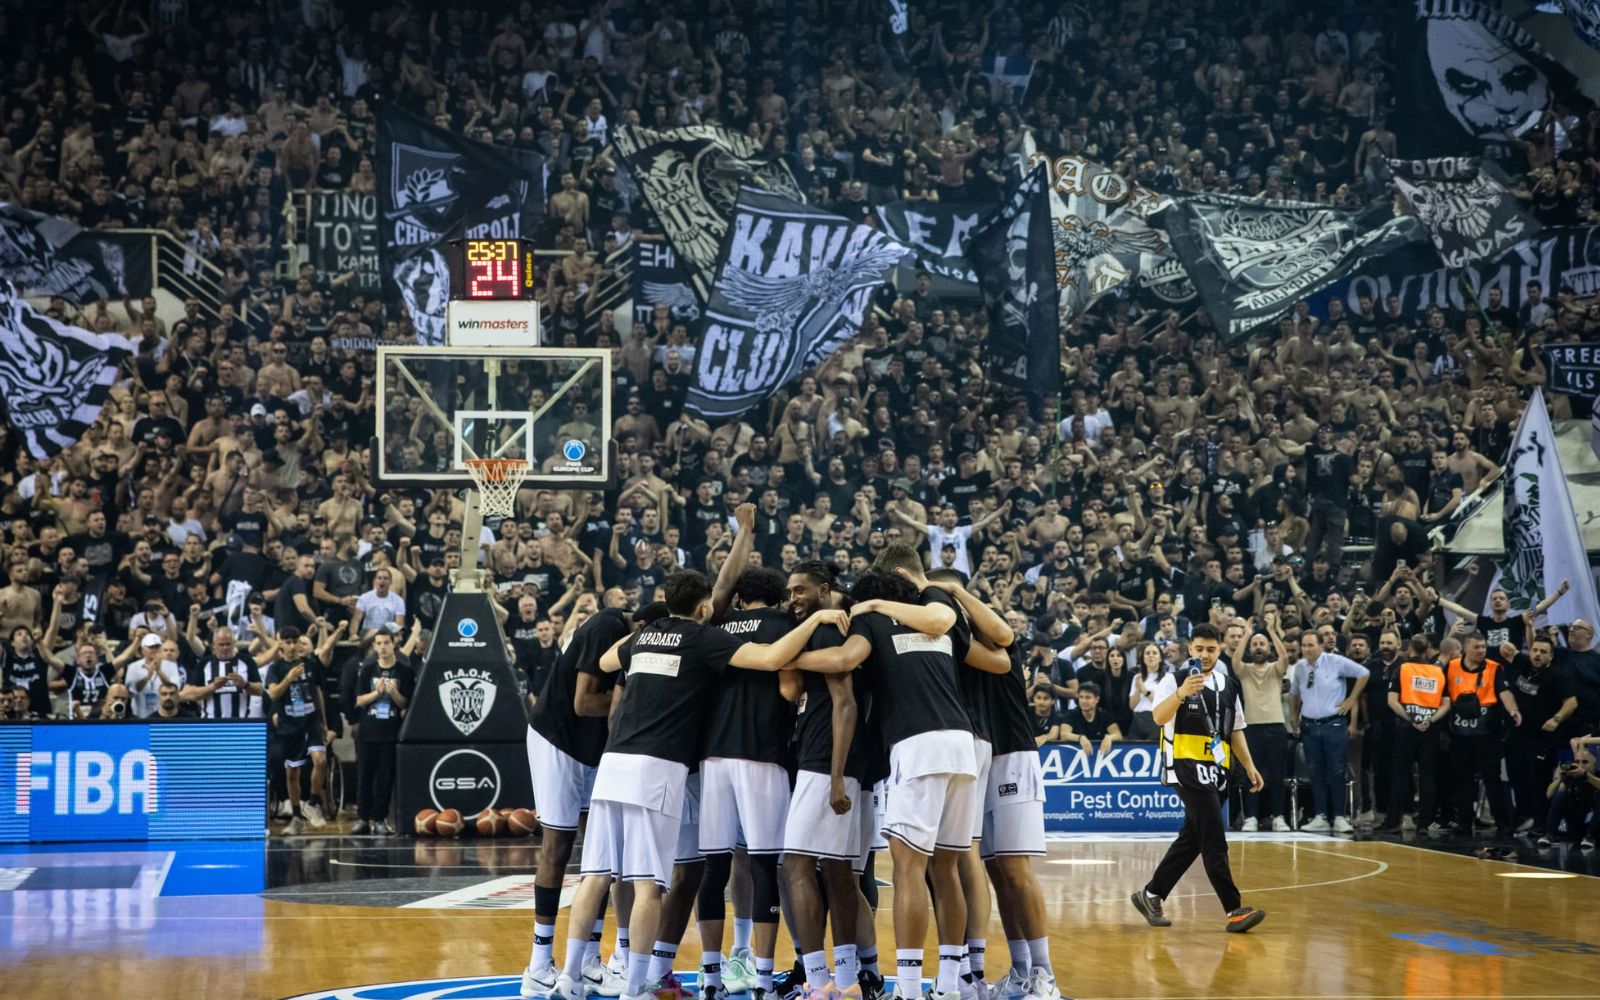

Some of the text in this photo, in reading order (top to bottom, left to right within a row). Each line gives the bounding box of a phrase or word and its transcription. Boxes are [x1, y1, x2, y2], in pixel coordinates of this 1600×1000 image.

[468, 241, 518, 261] 25:37
[471, 260, 519, 297] 24
[458, 319, 529, 330] winmasters
[1552, 347, 1600, 364] FREE
[636, 632, 682, 647] PAPADAKIS
[16, 749, 158, 816] FIBA
[435, 777, 495, 790] GSA
[1071, 791, 1112, 809] Pest
